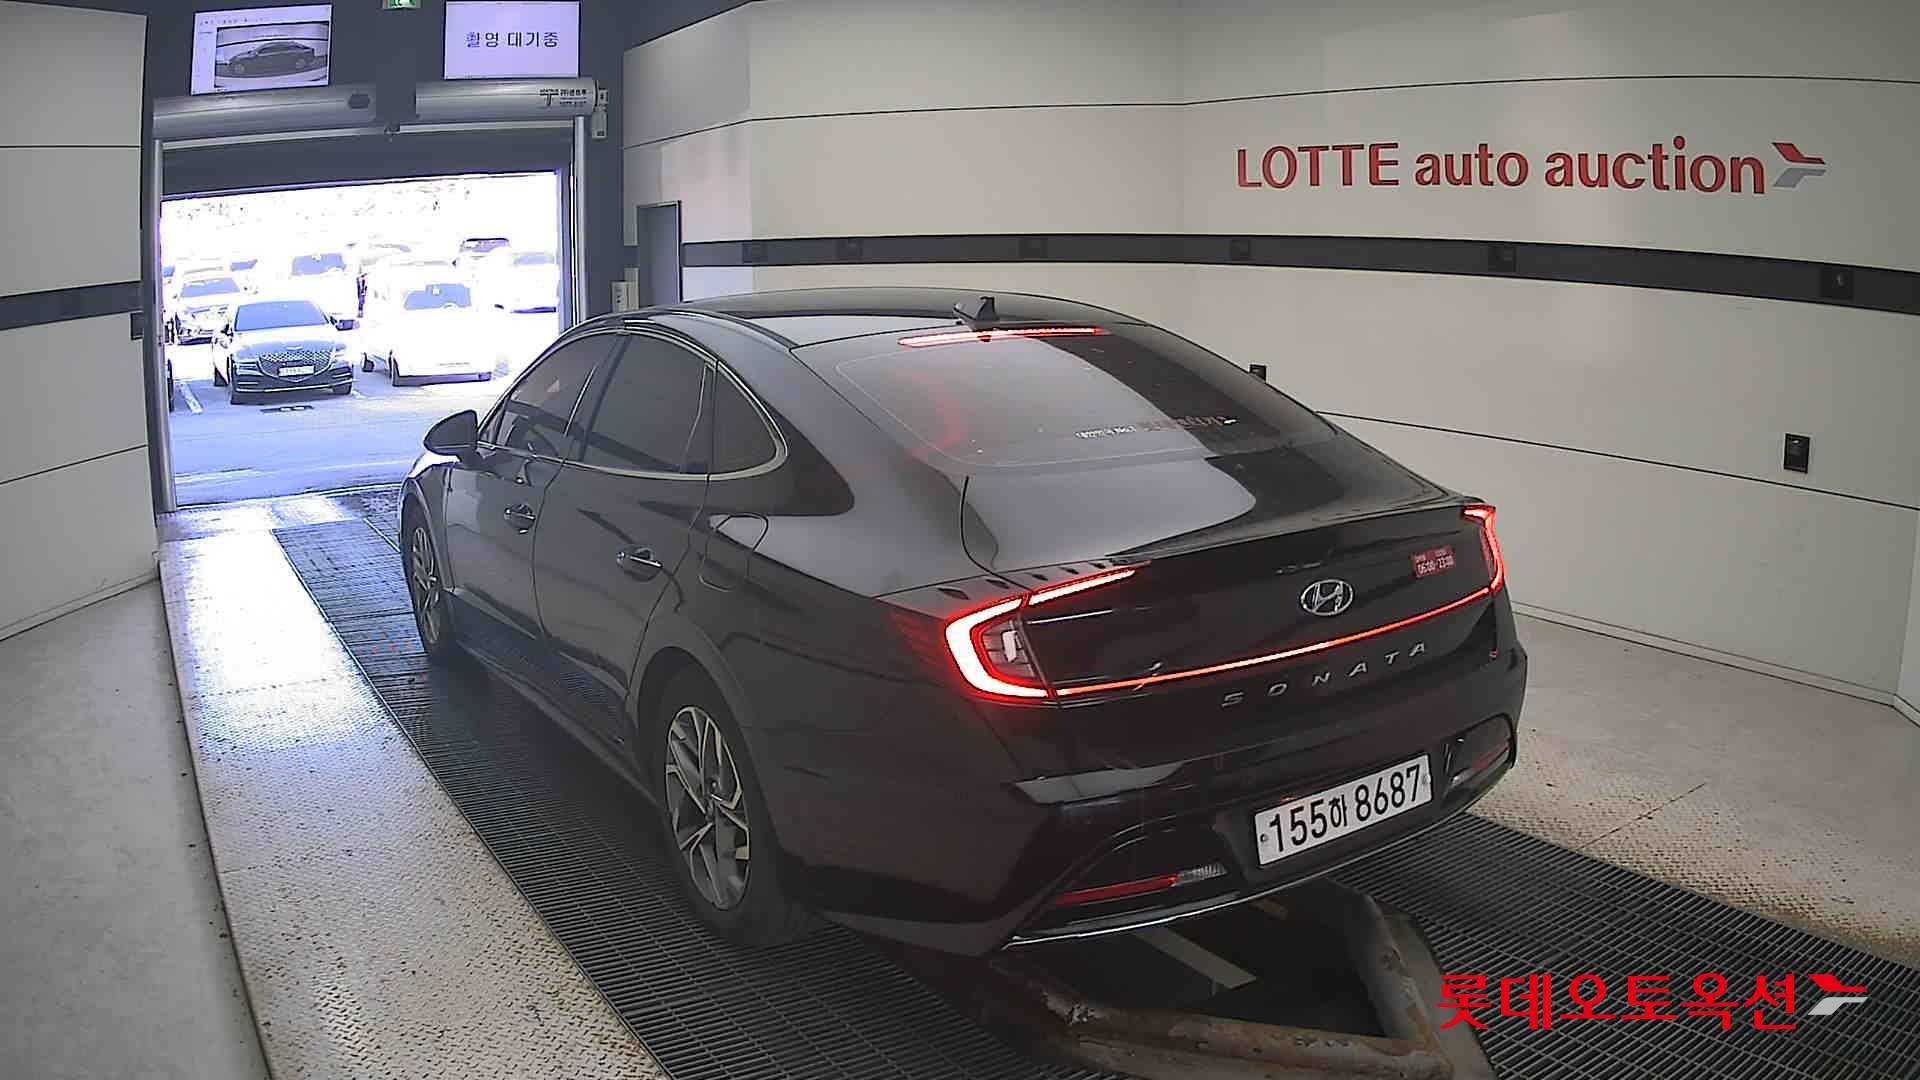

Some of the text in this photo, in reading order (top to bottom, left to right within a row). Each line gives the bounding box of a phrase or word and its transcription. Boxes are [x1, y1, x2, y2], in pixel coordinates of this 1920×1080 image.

[507, 31, 559, 48] 대기중
[1237, 135, 1765, 194] LOTTE auto auction
[1221, 642, 1426, 707] SONATA
[1268, 764, 1421, 853] 155하 8687
